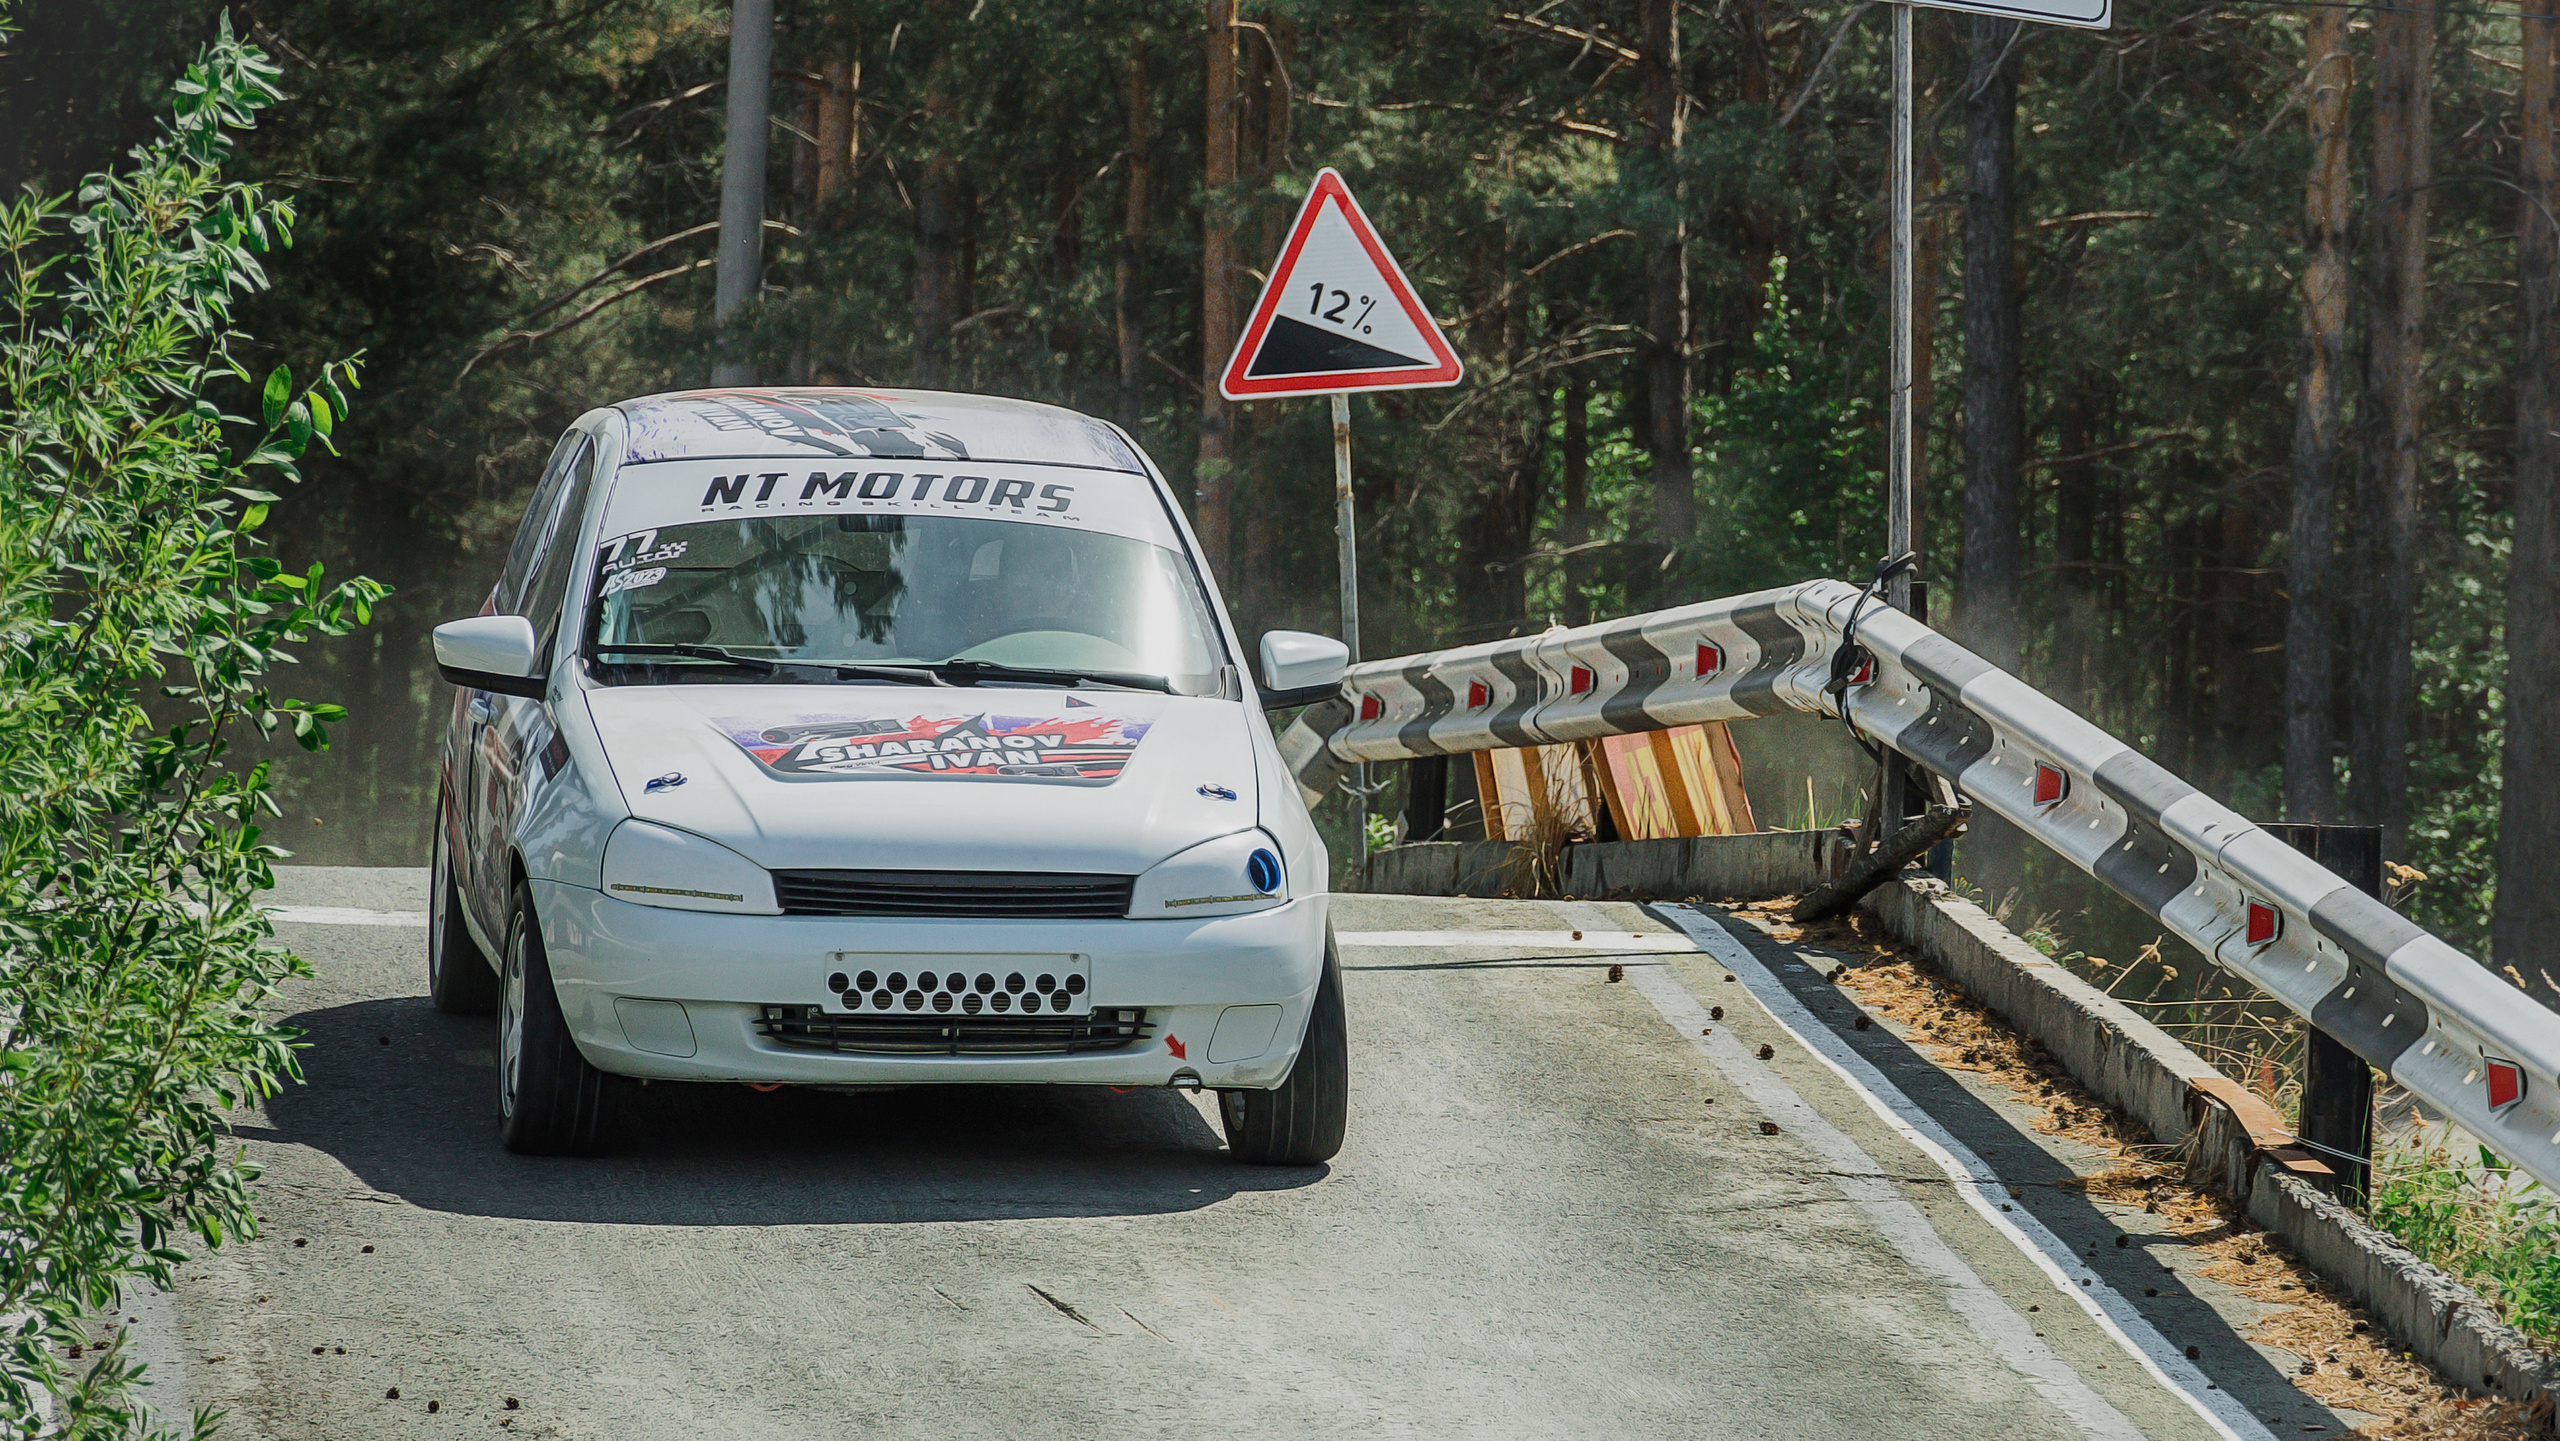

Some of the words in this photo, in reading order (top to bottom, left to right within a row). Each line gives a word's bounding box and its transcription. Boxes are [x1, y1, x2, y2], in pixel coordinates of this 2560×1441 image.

[1310, 282, 1377, 335] 12%
[701, 473, 789, 506] NT
[799, 471, 1075, 513] MOTORS
[701, 502, 841, 512] RACING
[862, 502, 965, 510] SKILL
[985, 506, 1081, 522] TEAM
[600, 530, 658, 563] 77
[818, 734, 1065, 763] SHARANOV
[928, 750, 1040, 770] IVAN
